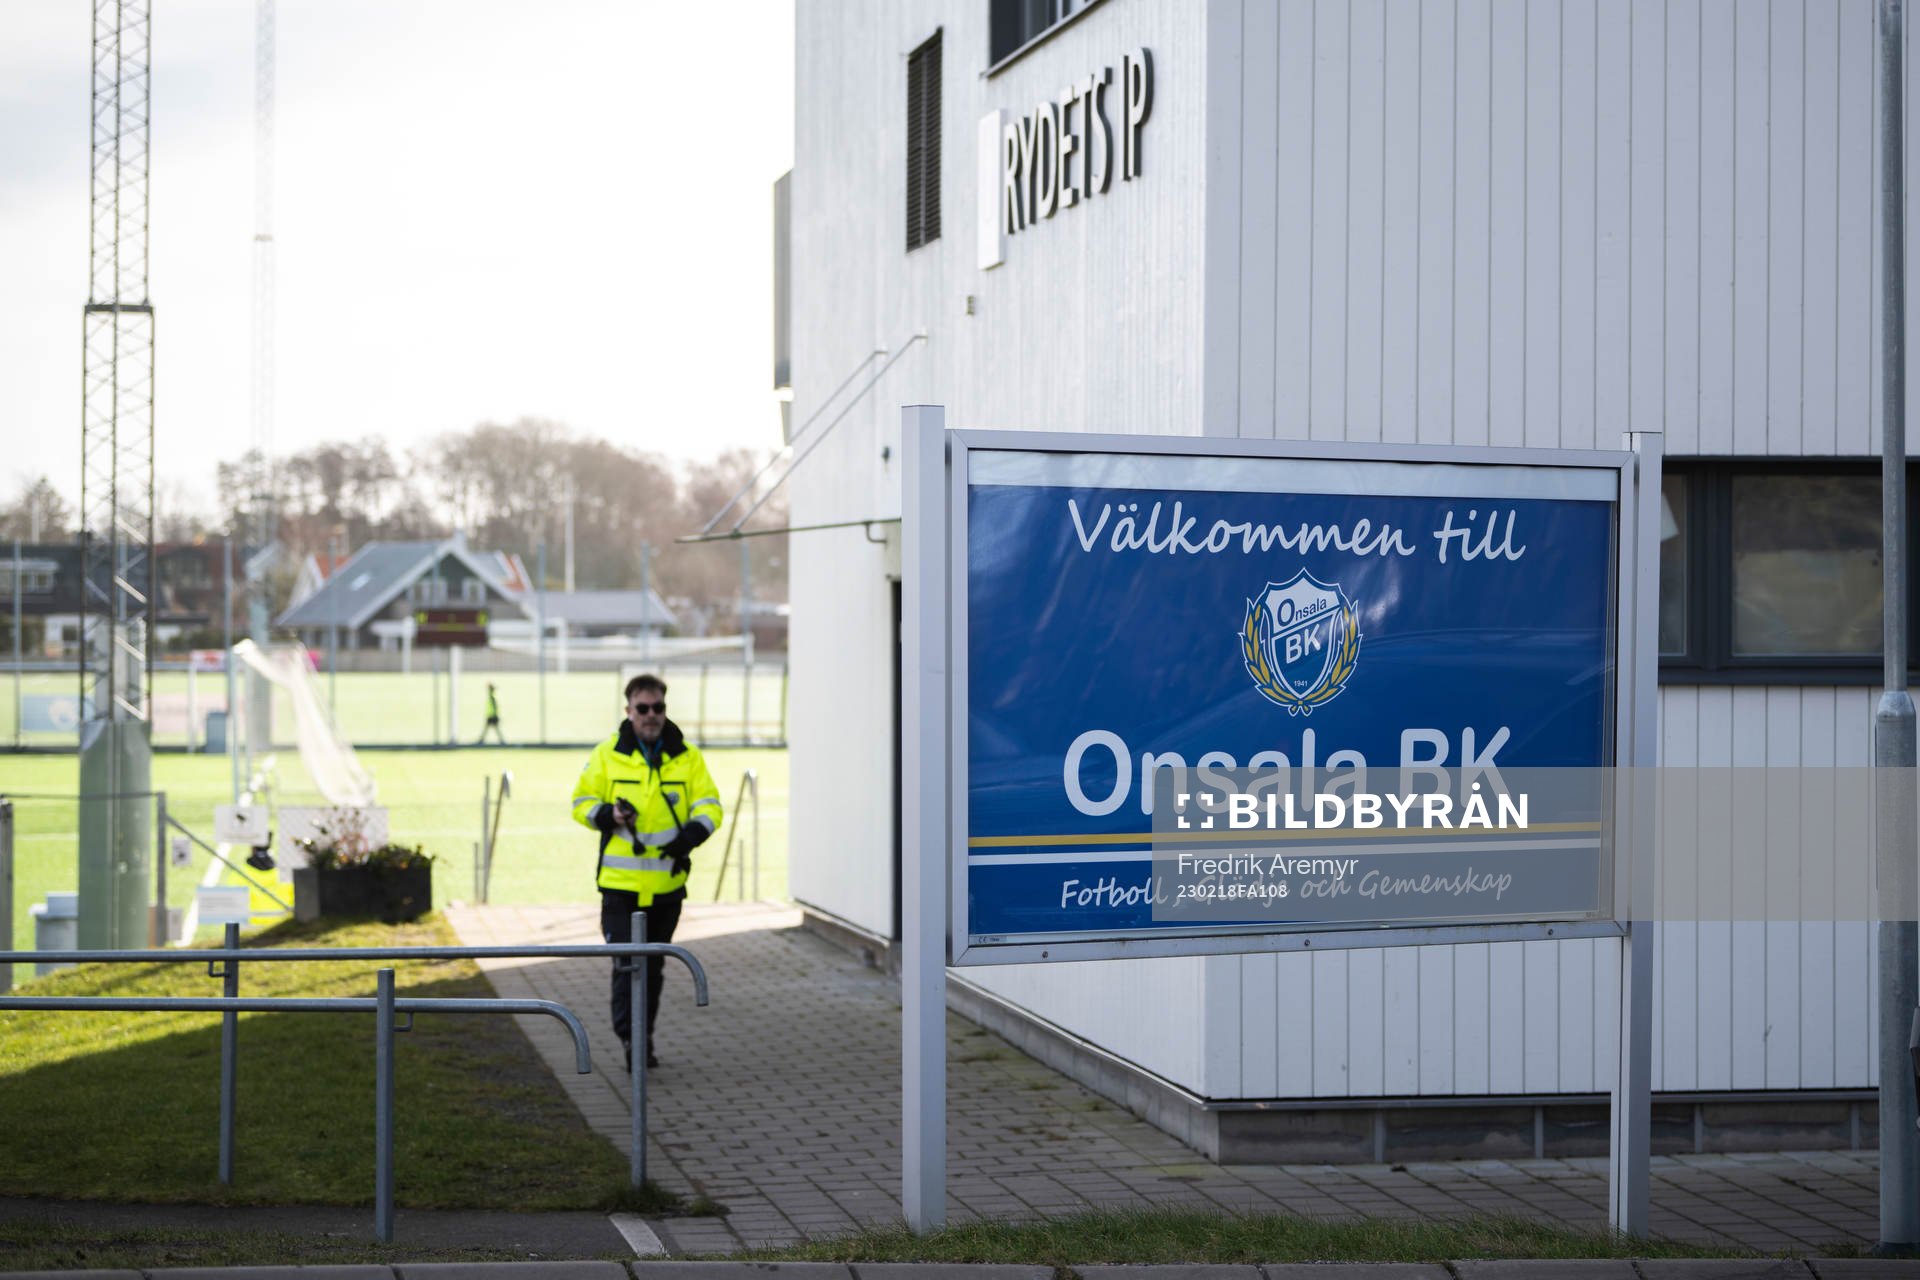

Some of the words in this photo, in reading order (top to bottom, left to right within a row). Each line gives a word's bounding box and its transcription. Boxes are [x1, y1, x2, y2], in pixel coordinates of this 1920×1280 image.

[1003, 66, 1114, 235] RYDETS
[1119, 47, 1155, 182] IP
[1067, 499, 1416, 557] Välkommen
[1433, 509, 1526, 564] till
[1277, 598, 1327, 627] Onsala
[1286, 623, 1321, 664] BK
[1063, 728, 1367, 817] Onsala
[1400, 726, 1512, 808] BK
[1301, 875, 1349, 899] och
[1358, 867, 1512, 901] Gemenskap
